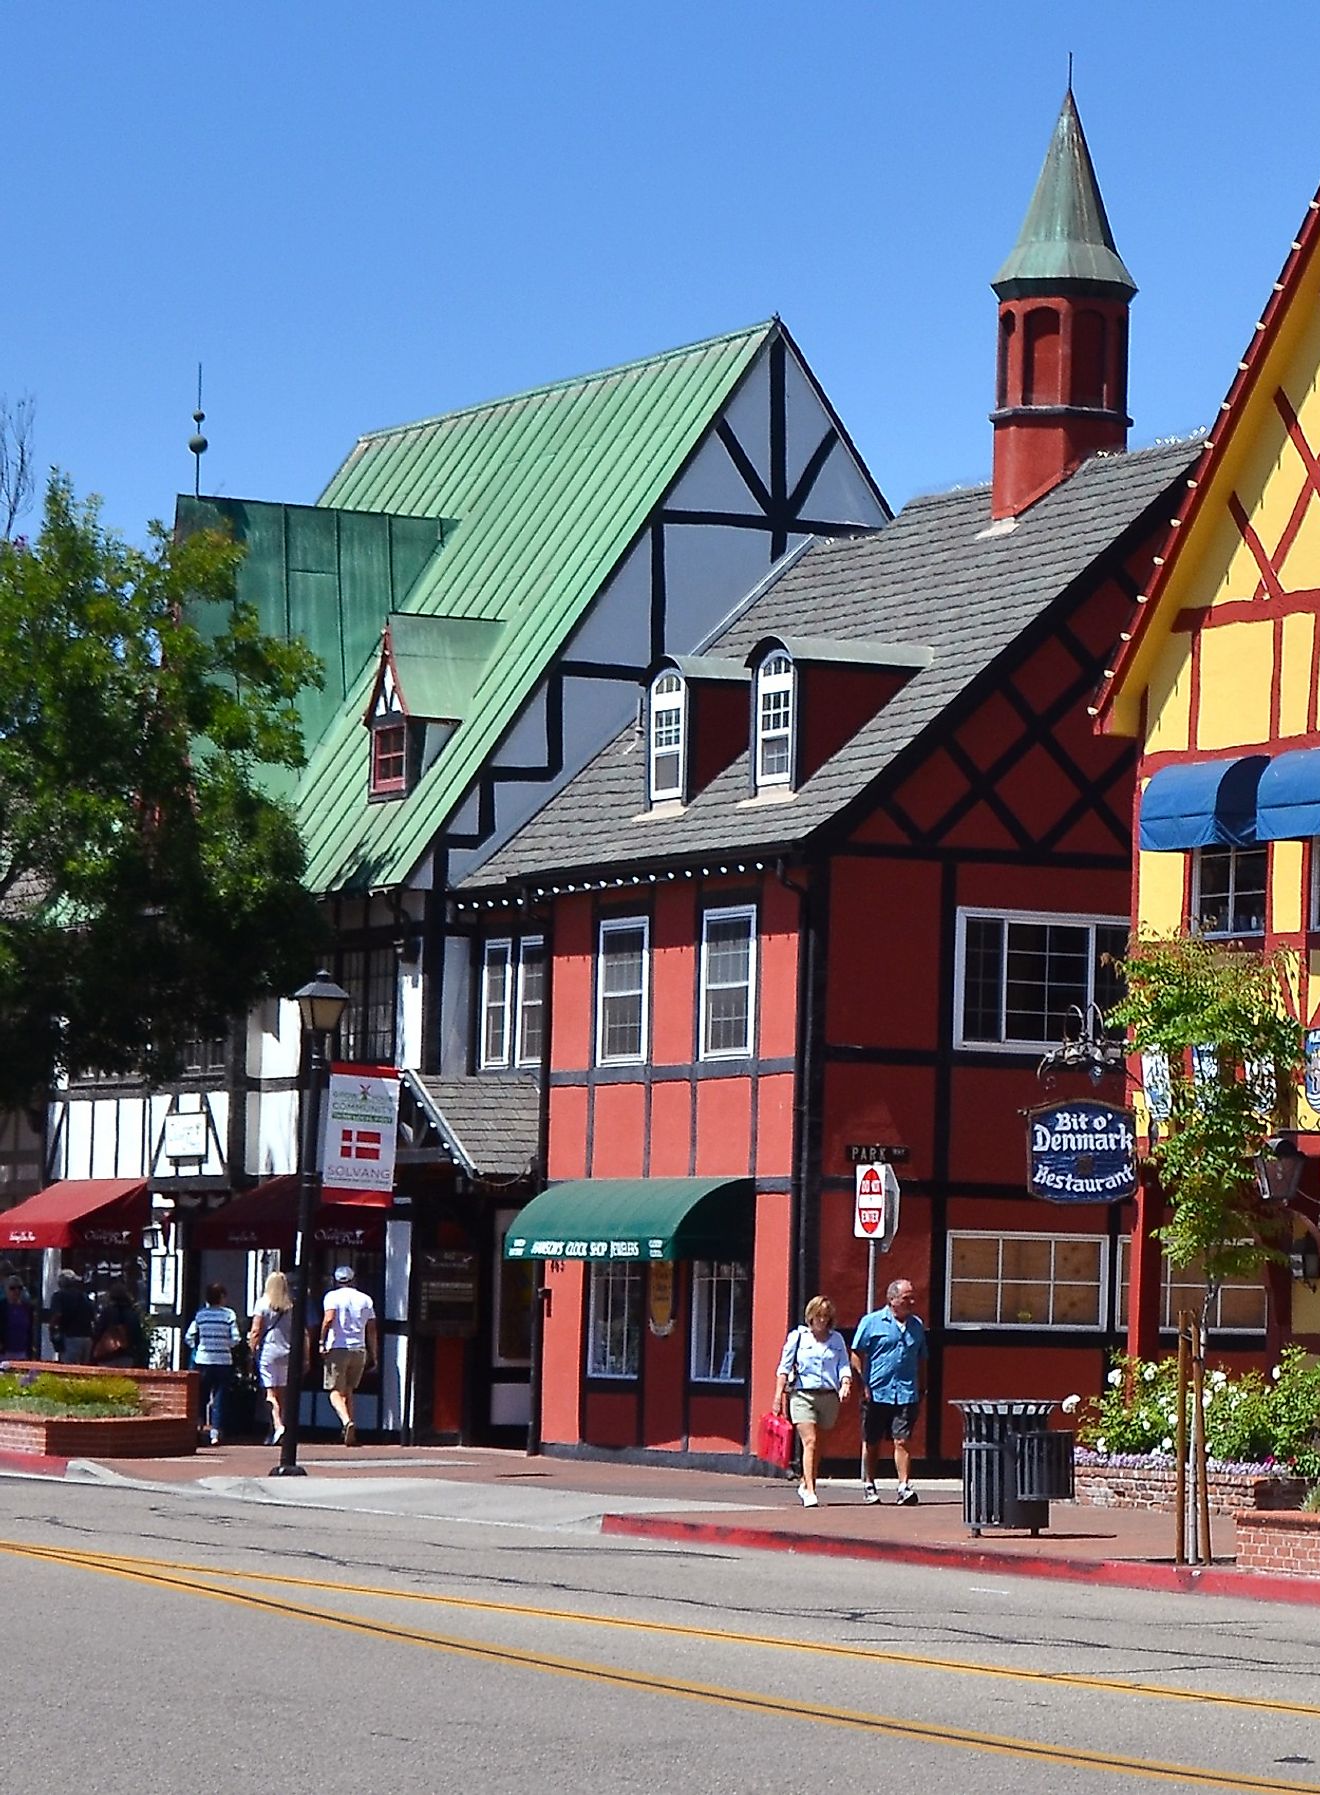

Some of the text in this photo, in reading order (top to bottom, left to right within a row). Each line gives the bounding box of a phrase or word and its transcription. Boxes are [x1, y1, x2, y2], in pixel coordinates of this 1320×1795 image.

[1055, 1112, 1088, 1131] Bit
[1032, 1123, 1133, 1157] Denmark
[851, 1147, 886, 1161] PARK
[327, 1165, 390, 1179] SOLVANG
[1032, 1163, 1134, 1192] Restaurant
[861, 1180, 881, 1193] DO NOT
[861, 1209, 879, 1223] ENTER
[565, 1240, 588, 1256] CLOCK
[589, 1241, 608, 1256] SHOP
